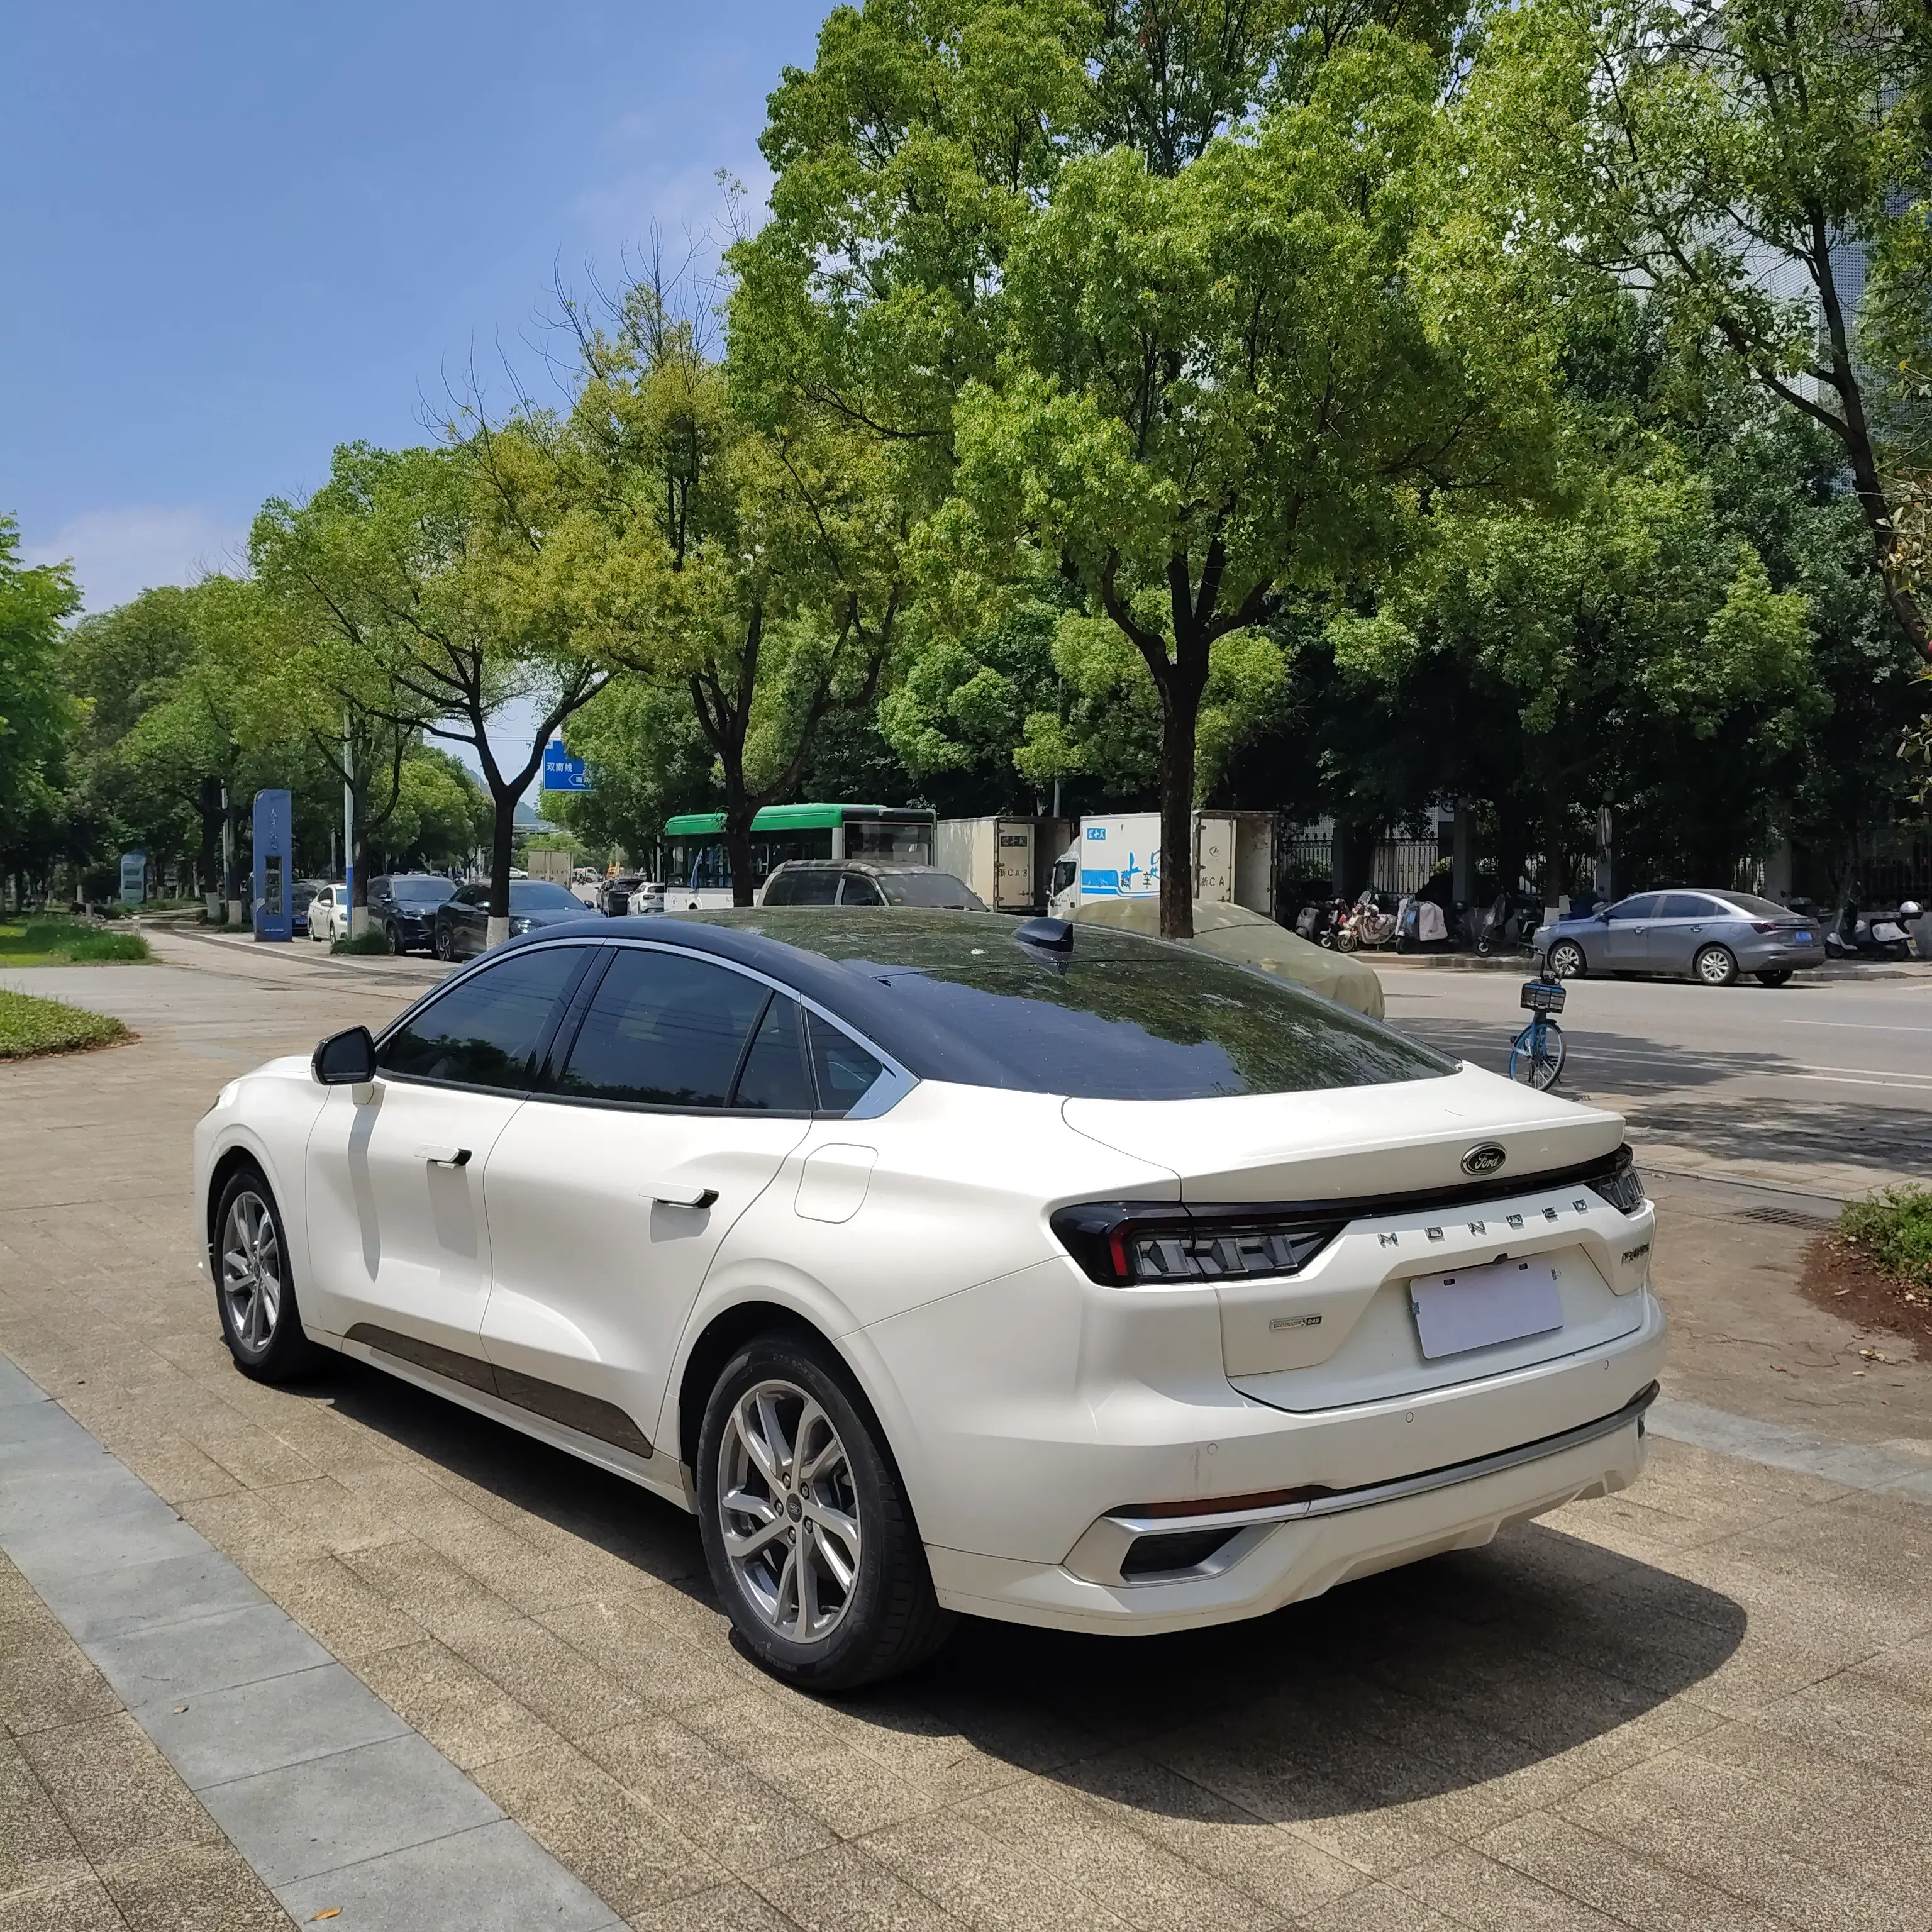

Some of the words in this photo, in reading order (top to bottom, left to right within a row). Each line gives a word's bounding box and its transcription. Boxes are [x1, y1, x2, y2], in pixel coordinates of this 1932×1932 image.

[547, 762, 573, 772] 双南线
[1474, 1152, 1499, 1169] Ford
[1377, 1199, 1589, 1248] MONDEO
